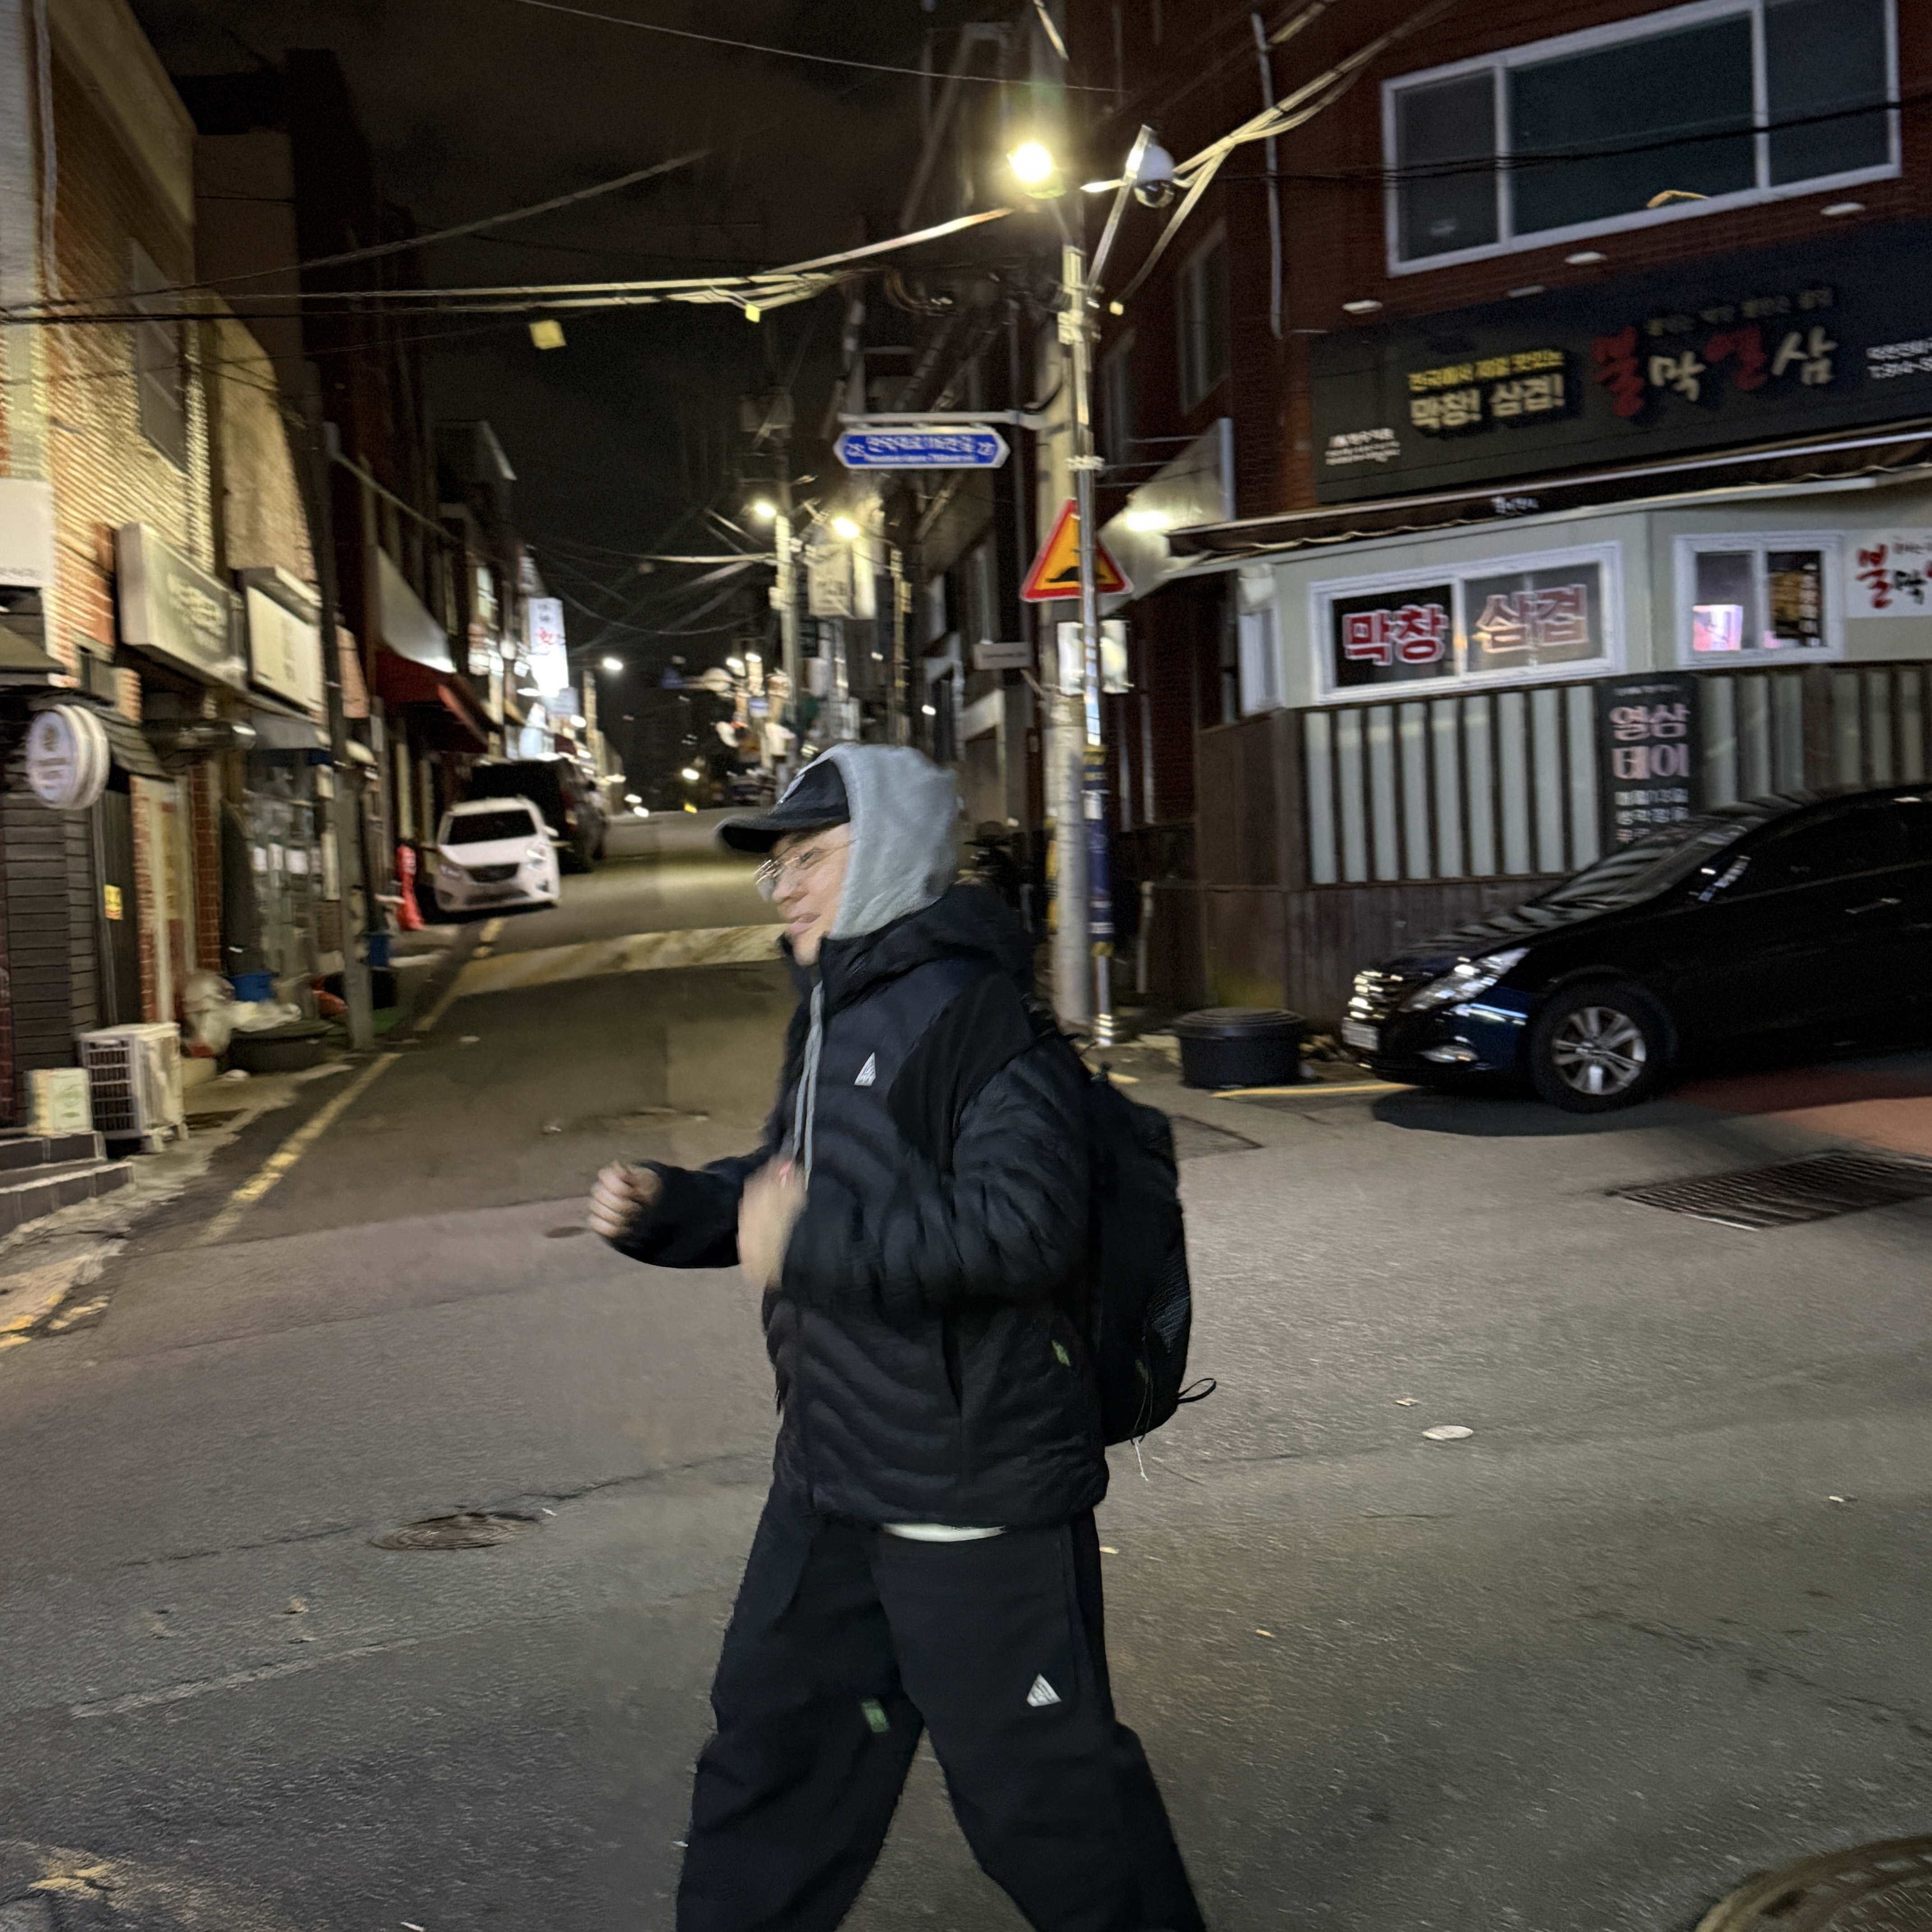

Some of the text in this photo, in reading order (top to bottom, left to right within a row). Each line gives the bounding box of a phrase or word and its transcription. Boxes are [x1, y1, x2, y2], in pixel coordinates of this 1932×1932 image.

[1342, 584, 1589, 667] 막창 삼겹
[1609, 703, 1691, 741] 열삼
[1611, 743, 1689, 780] 데이
